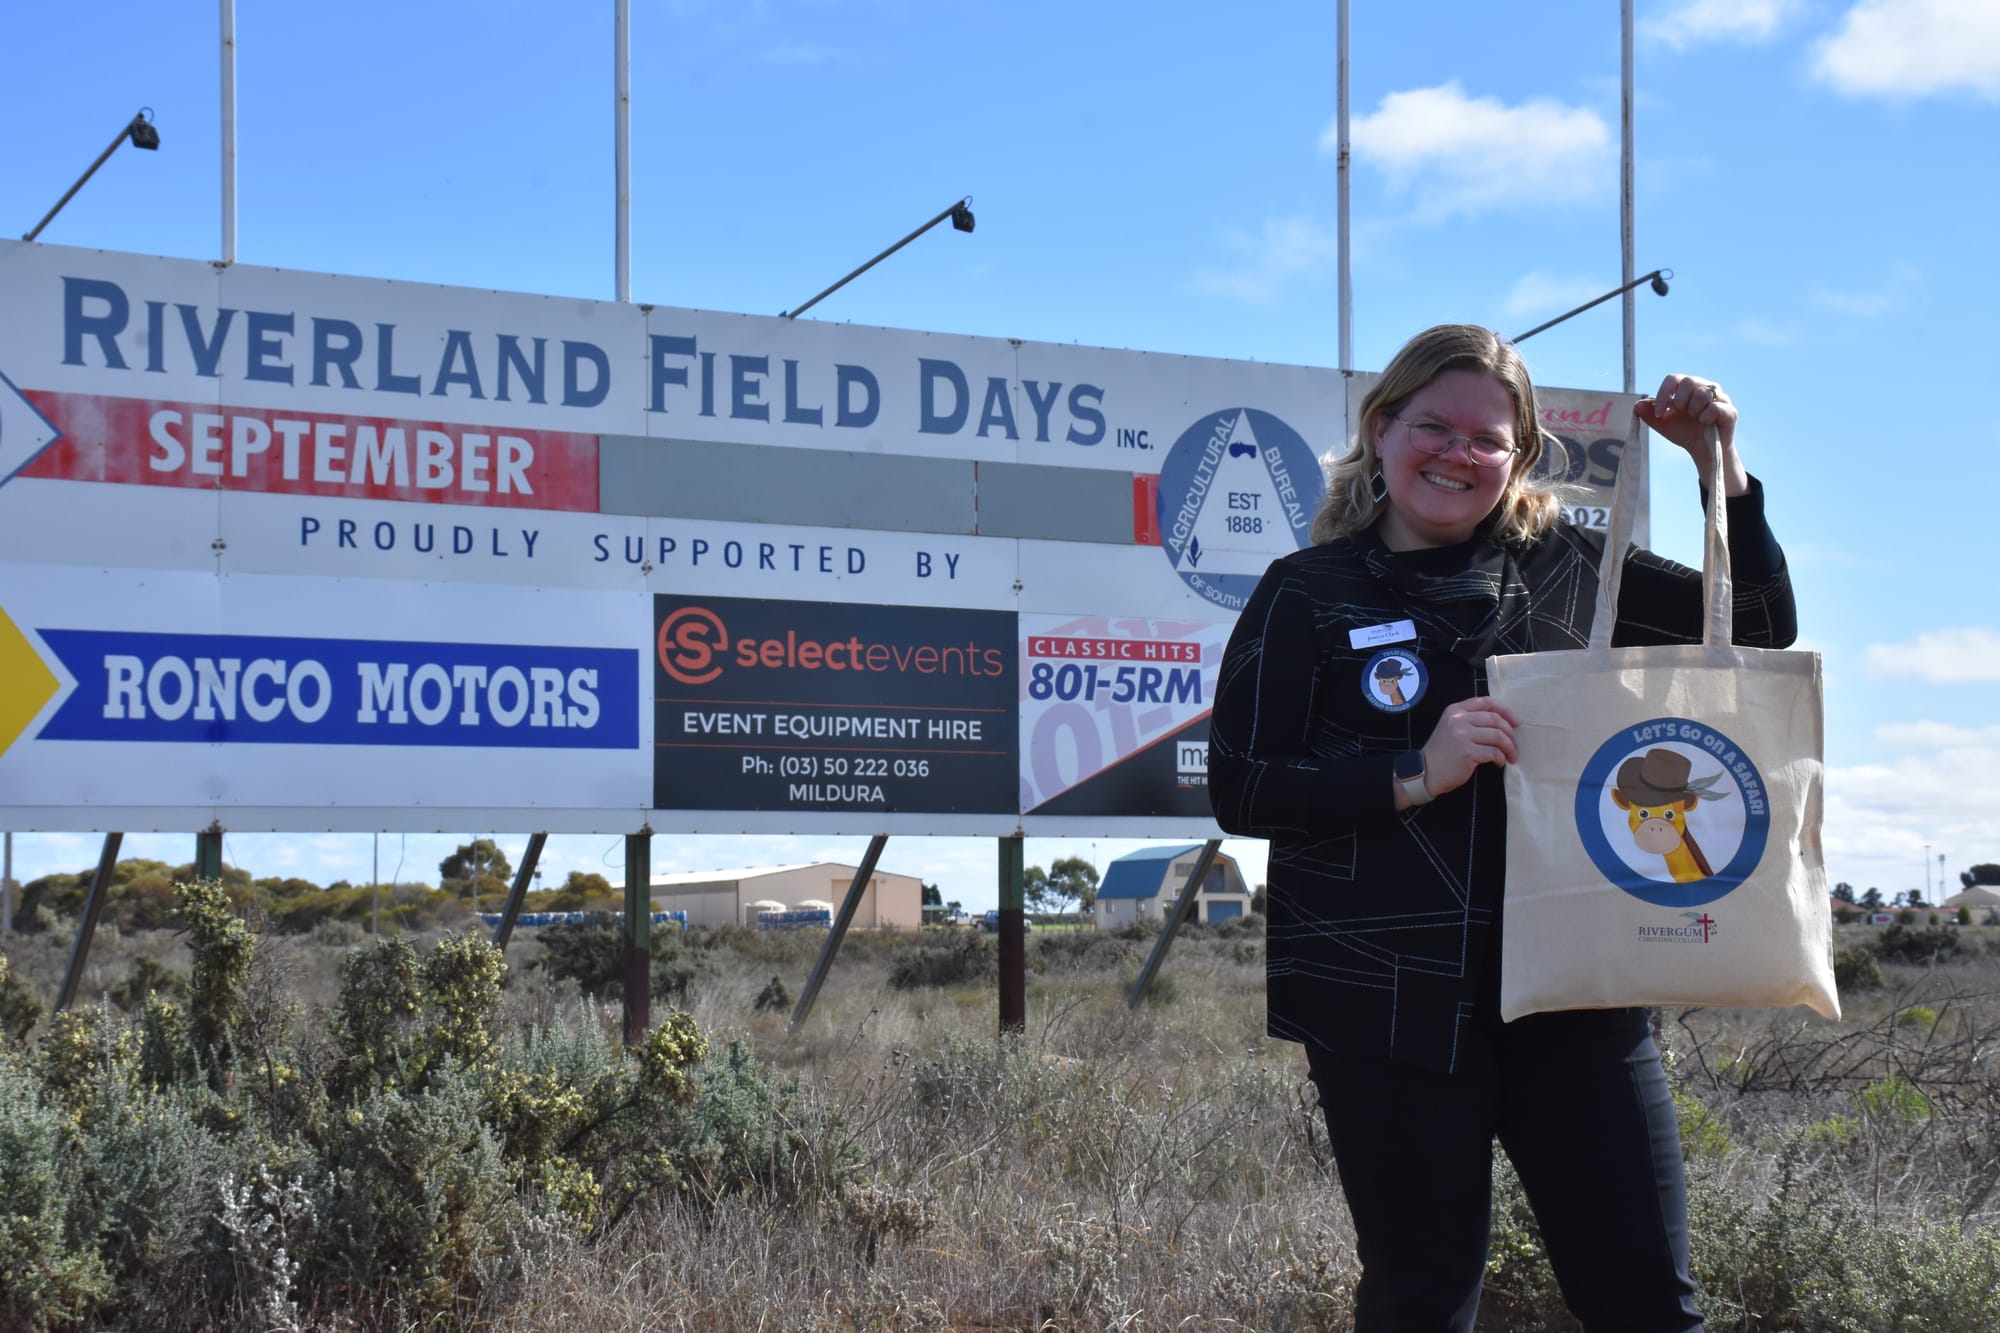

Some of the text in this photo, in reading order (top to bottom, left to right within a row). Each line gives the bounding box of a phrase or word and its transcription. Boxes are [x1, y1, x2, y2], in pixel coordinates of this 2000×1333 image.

[60, 276, 1154, 450] RIVERLAND FIELD DAYS INC.
[148, 410, 535, 496] SEPTEMBER
[1168, 417, 1236, 553] AGRICULTURAL
[1228, 492, 1261, 510] EST
[1264, 446, 1307, 529] BUREAU
[1226, 516, 1262, 534] 1888
[300, 517, 960, 580] PROUDLY SUPPORTED BY
[1190, 574, 1206, 588] OF
[1204, 585, 1240, 608] SOUTH
[736, 630, 1003, 677] selectevents
[1035, 640, 1194, 659] CLASSIC HITS
[103, 655, 600, 729] RONCO MOTORS
[1028, 663, 1202, 704] 801-5RM
[683, 712, 982, 740] EVENT EQUIPMENT HIRE
[742, 756, 929, 778] Ph: (03) 50 222 036
[1177, 776, 1190, 785] THE
[1190, 776, 1200, 785] HIT
[1680, 725, 1701, 740] GO
[1723, 751, 1736, 765] A
[1732, 761, 1764, 815] SAFARI
[789, 784, 885, 802] MILDURA
[1638, 926, 1702, 937] RIVERGUM
